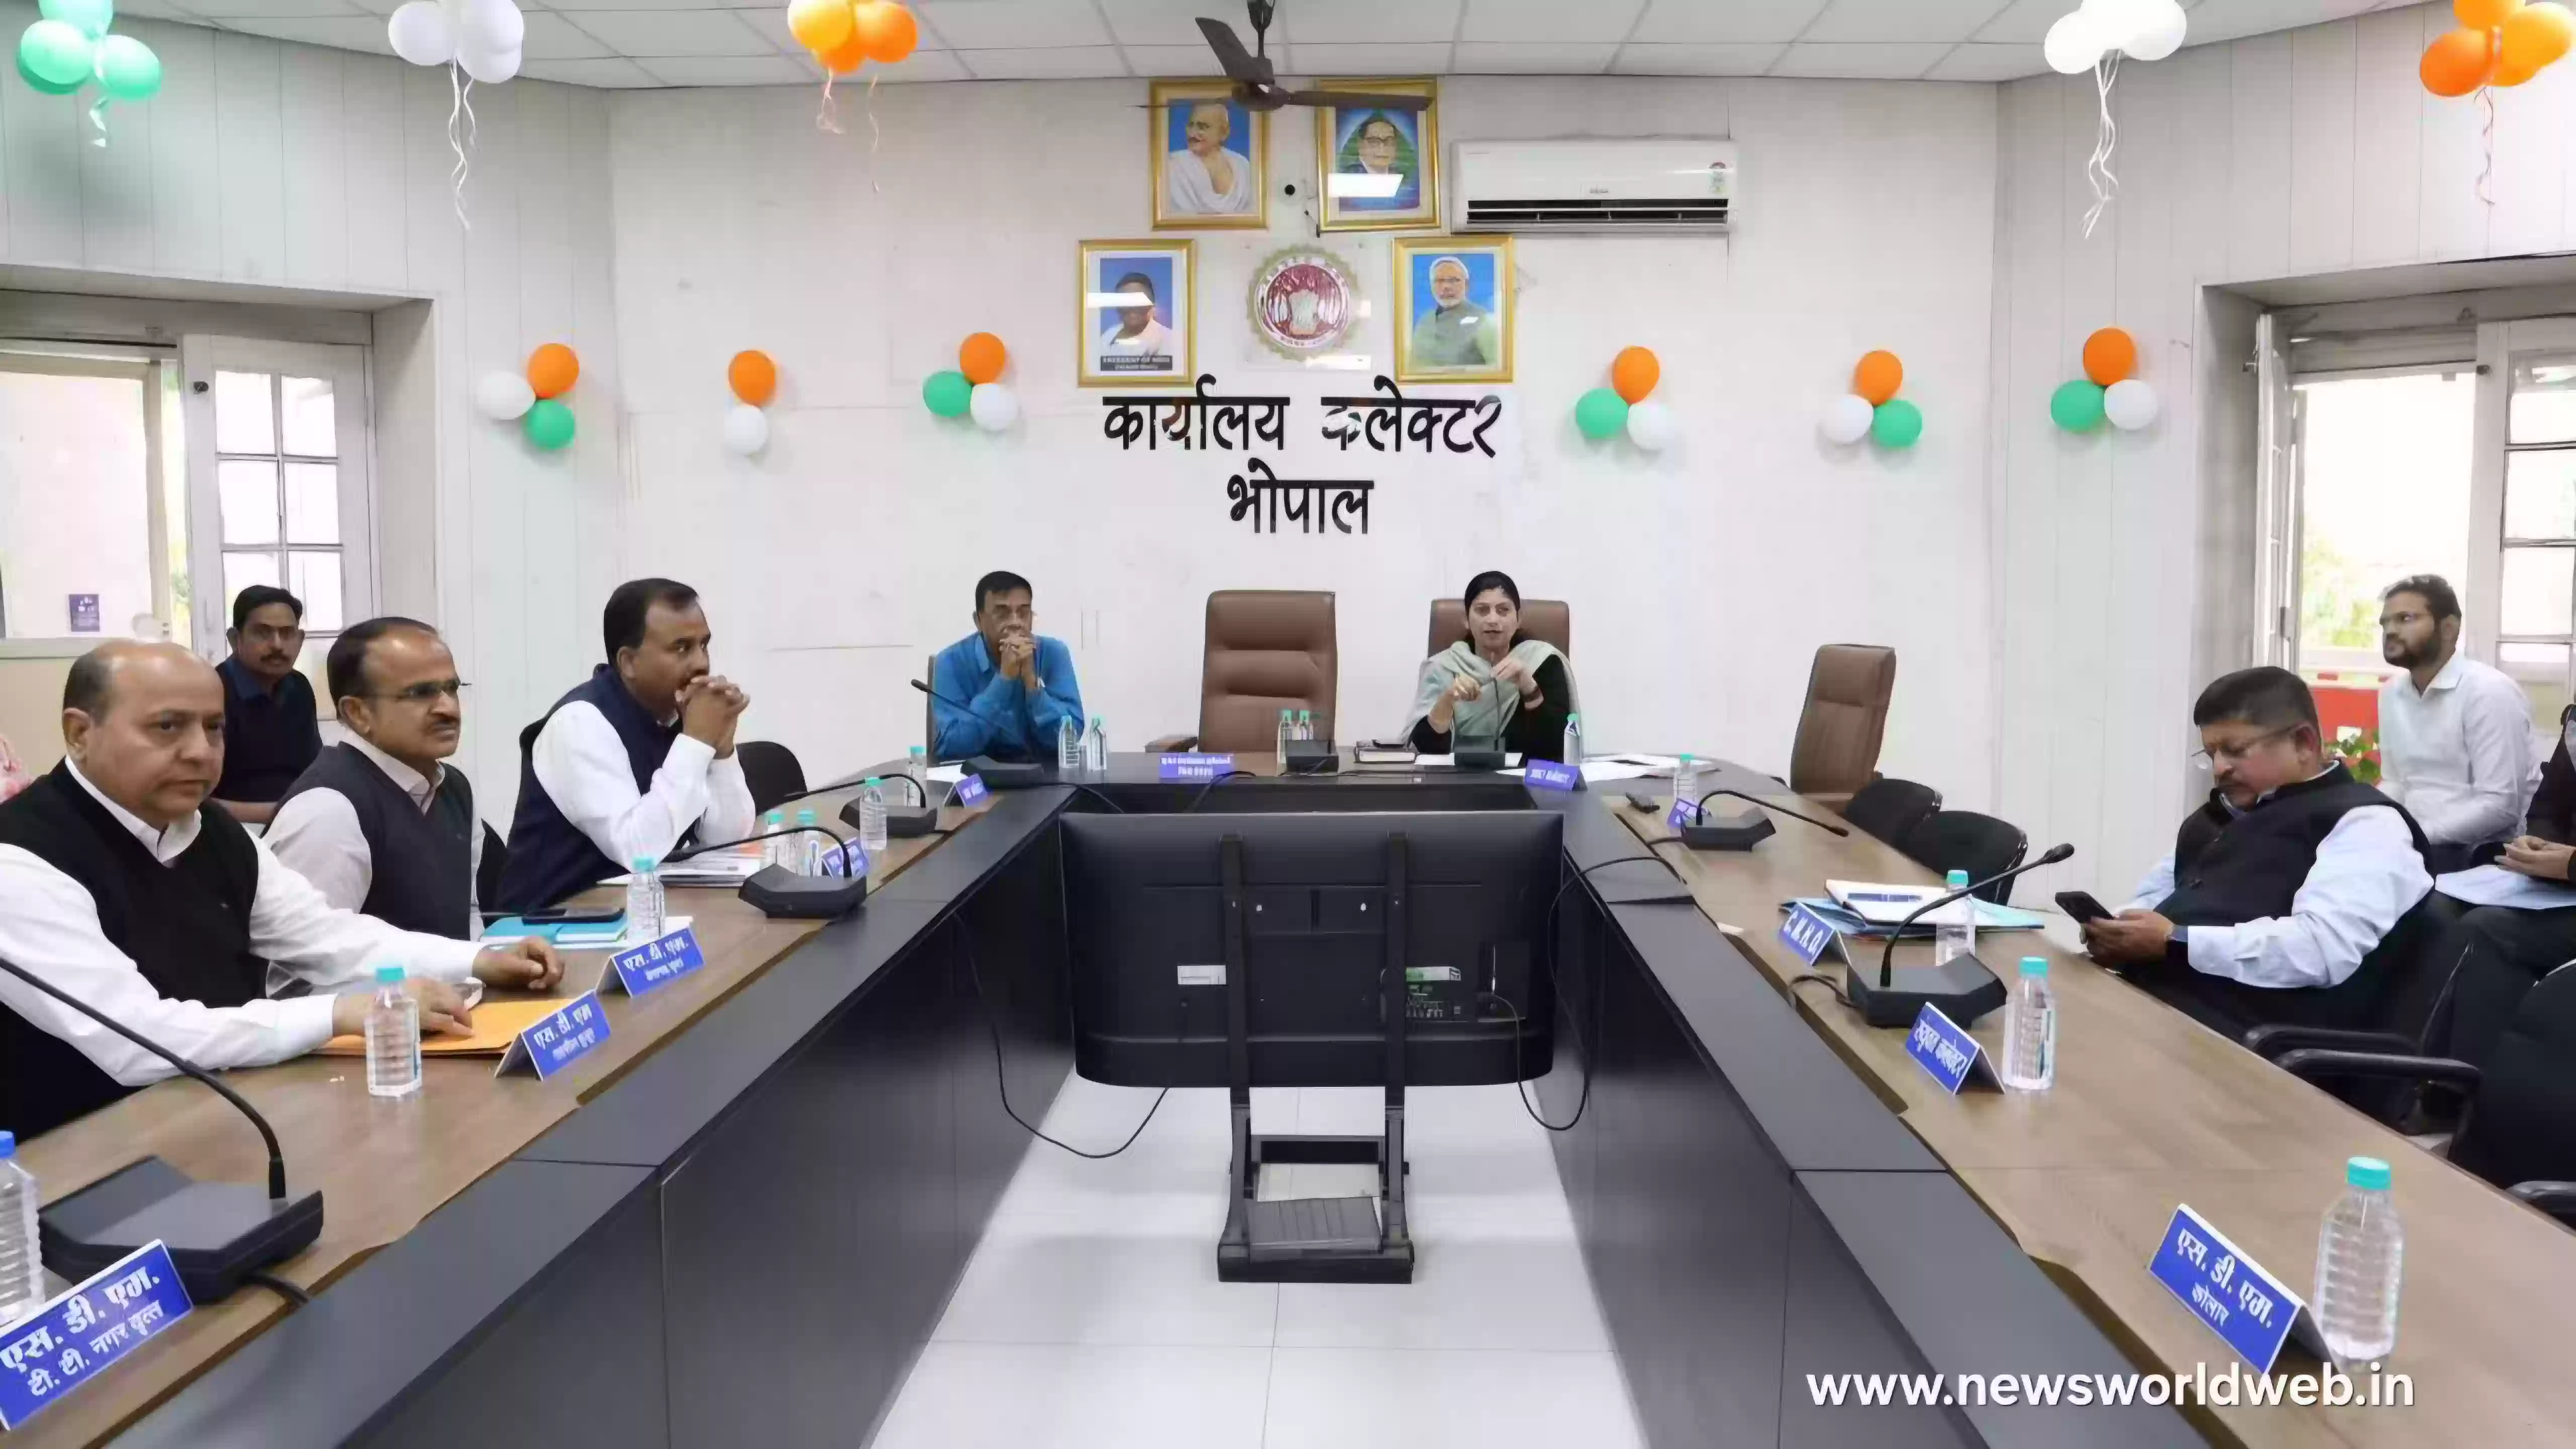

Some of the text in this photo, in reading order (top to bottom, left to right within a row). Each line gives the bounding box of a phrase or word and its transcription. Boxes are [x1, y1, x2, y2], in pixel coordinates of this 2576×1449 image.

[1102, 374, 1502, 458] कार्यालय कलेक्टर
[1227, 457, 1375, 534] भोपाल
[0, 1266, 159, 1373] एस. डी. एम.
[2177, 1228, 2273, 1328] एस. डी. एम.
[89, 1323, 129, 1353] नगर
